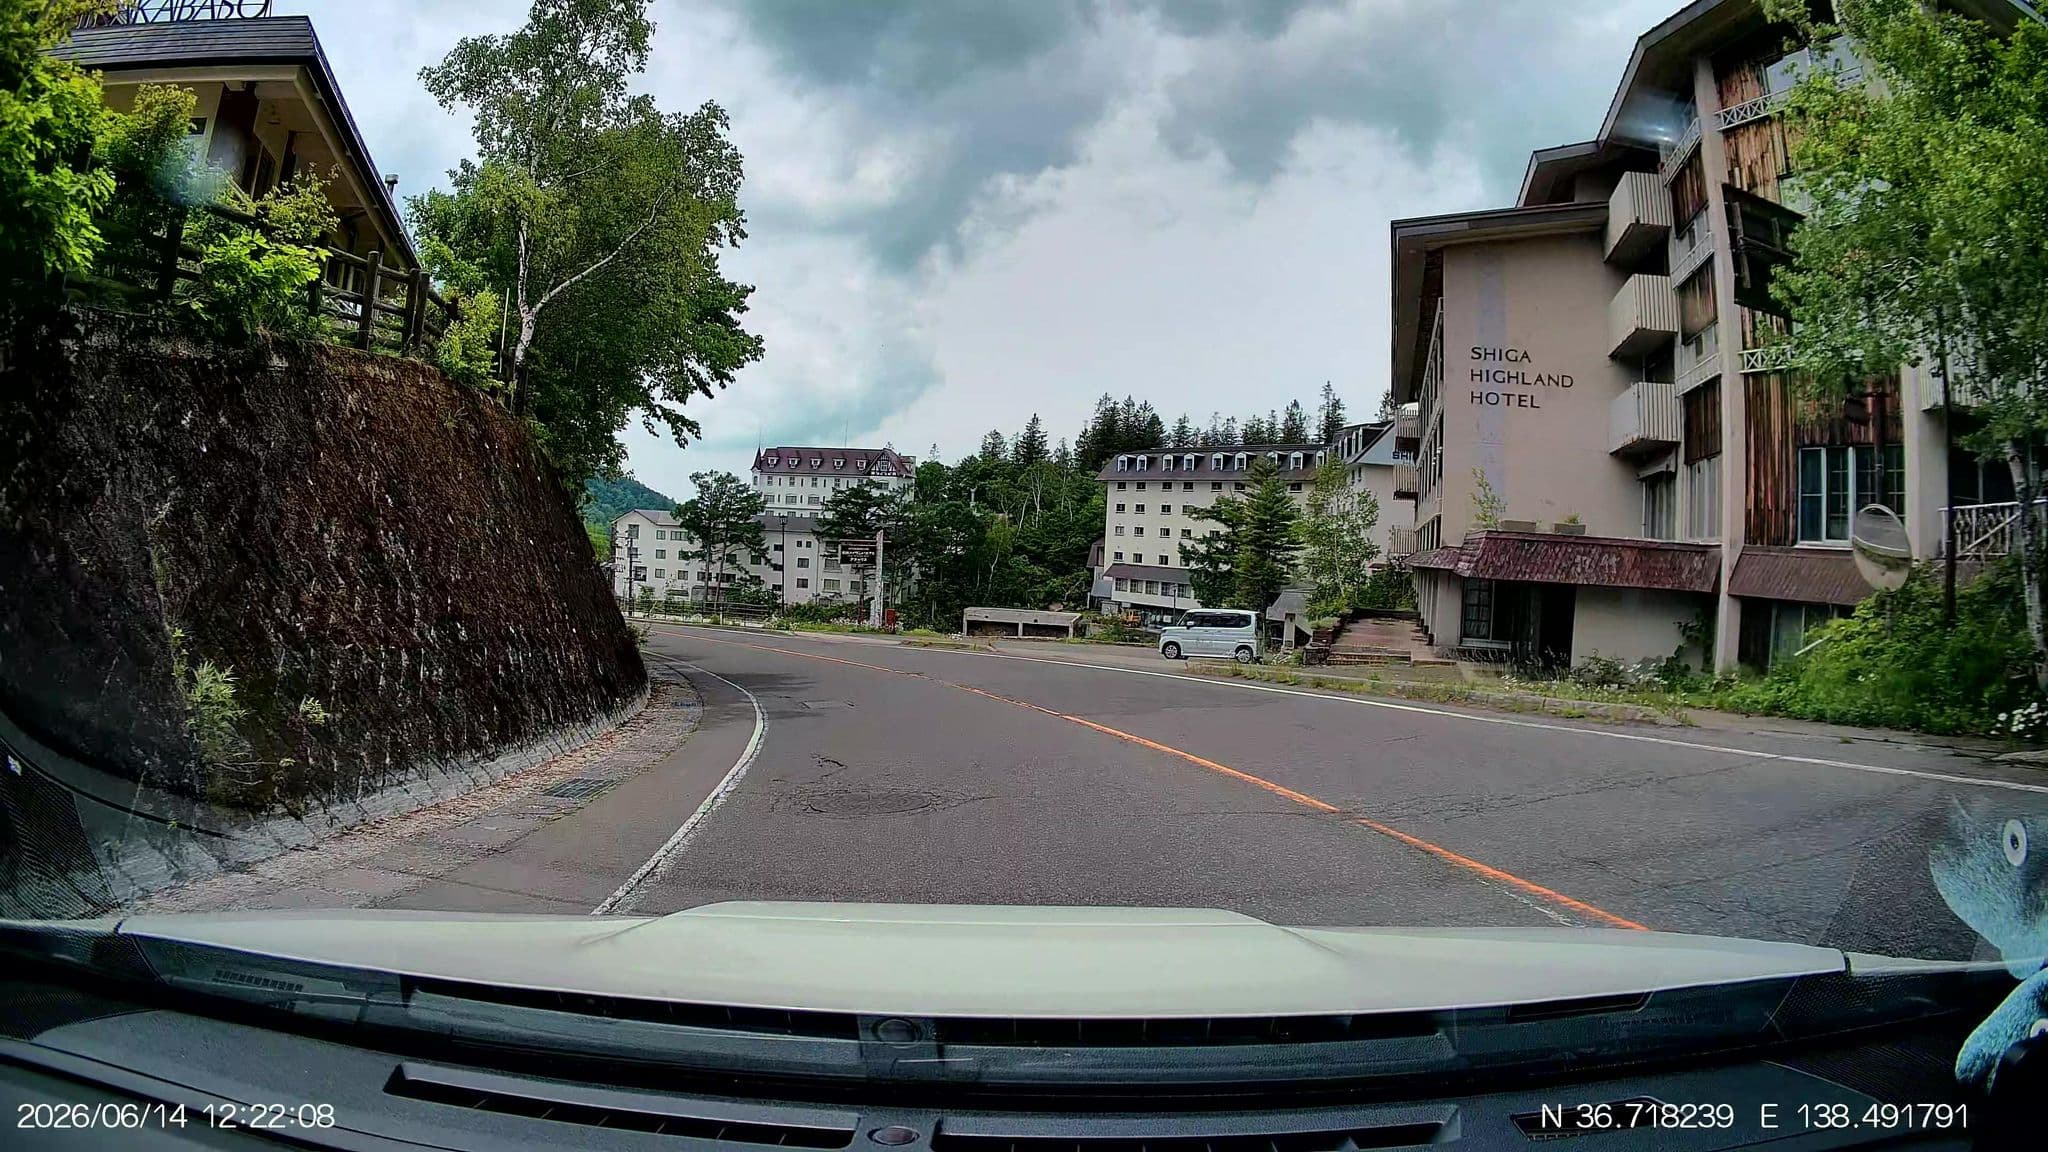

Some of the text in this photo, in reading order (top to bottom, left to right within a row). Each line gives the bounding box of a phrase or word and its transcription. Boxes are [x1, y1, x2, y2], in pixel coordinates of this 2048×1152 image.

[1470, 346, 1532, 364] SHIGA
[1470, 368, 1574, 389] HIGHLAND
[1470, 390, 1541, 409] HOTEL
